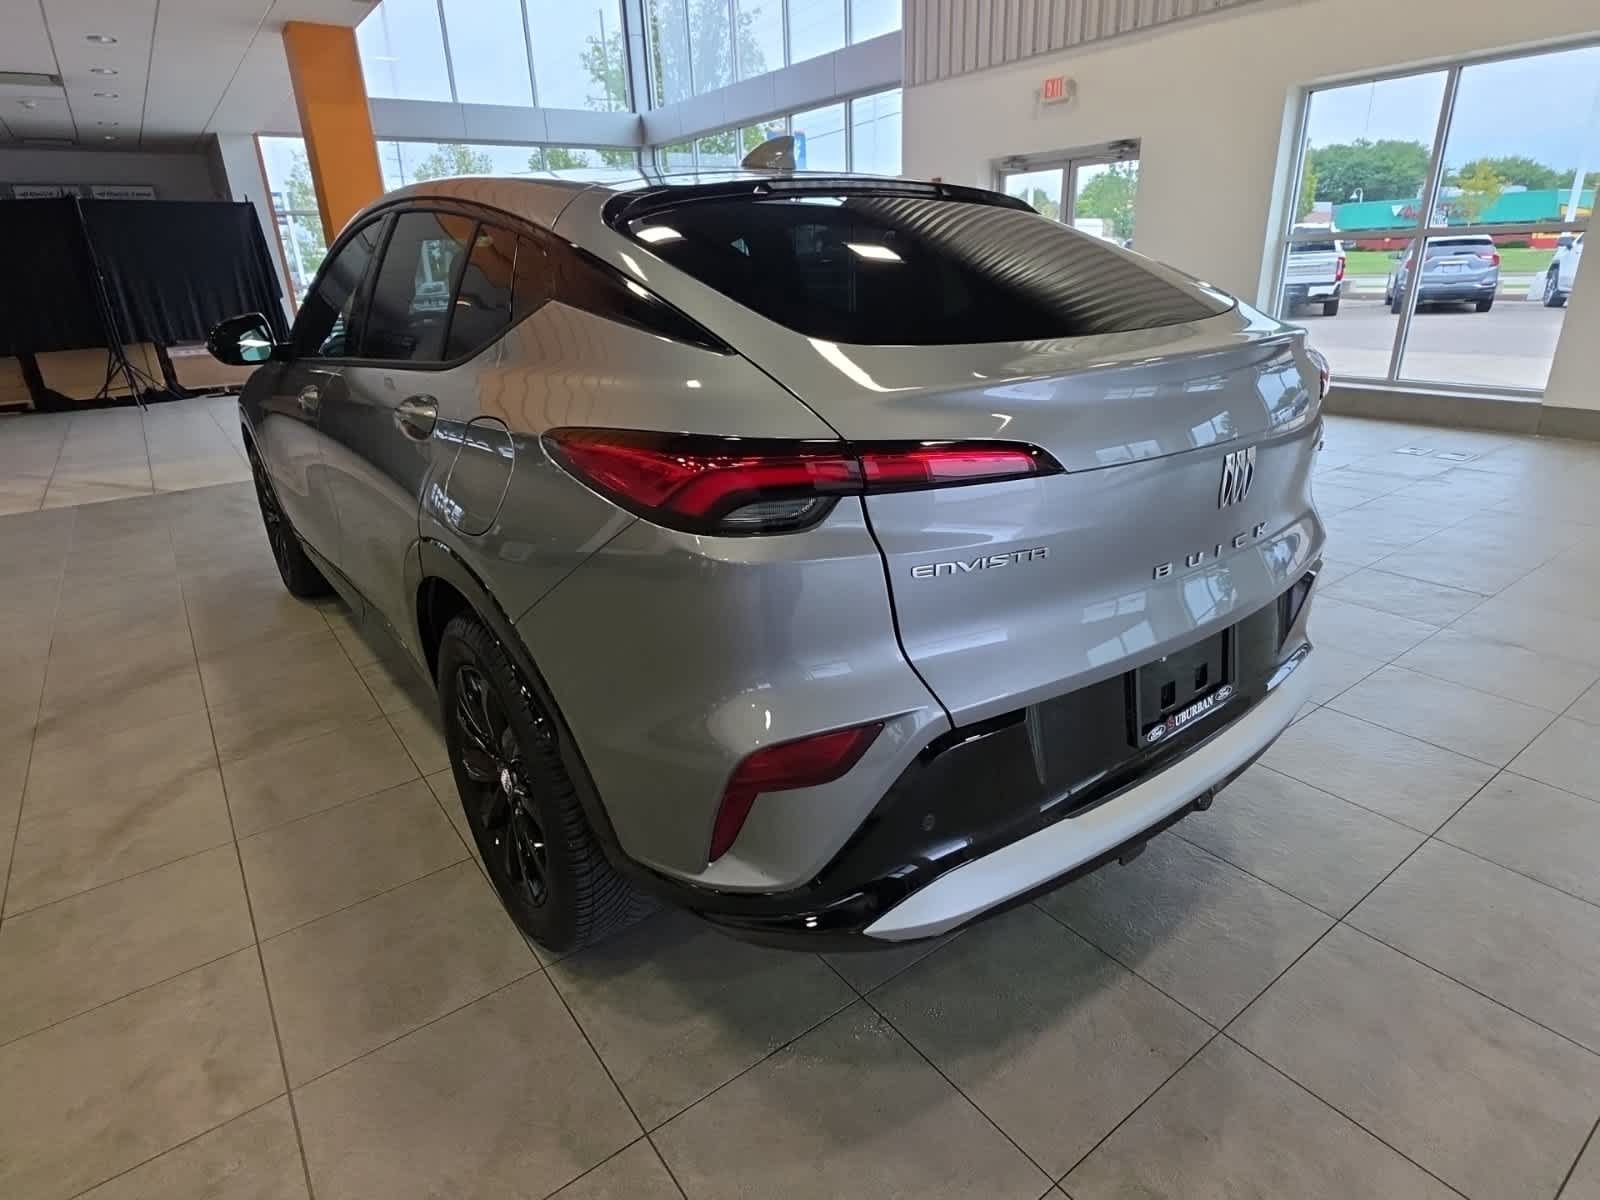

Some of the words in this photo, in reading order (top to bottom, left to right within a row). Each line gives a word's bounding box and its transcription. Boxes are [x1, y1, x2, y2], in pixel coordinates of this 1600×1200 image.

[911, 546, 1049, 579] ENVISTA
[1153, 521, 1269, 580] BUICK
[1167, 695, 1214, 730] SUBURBAN
